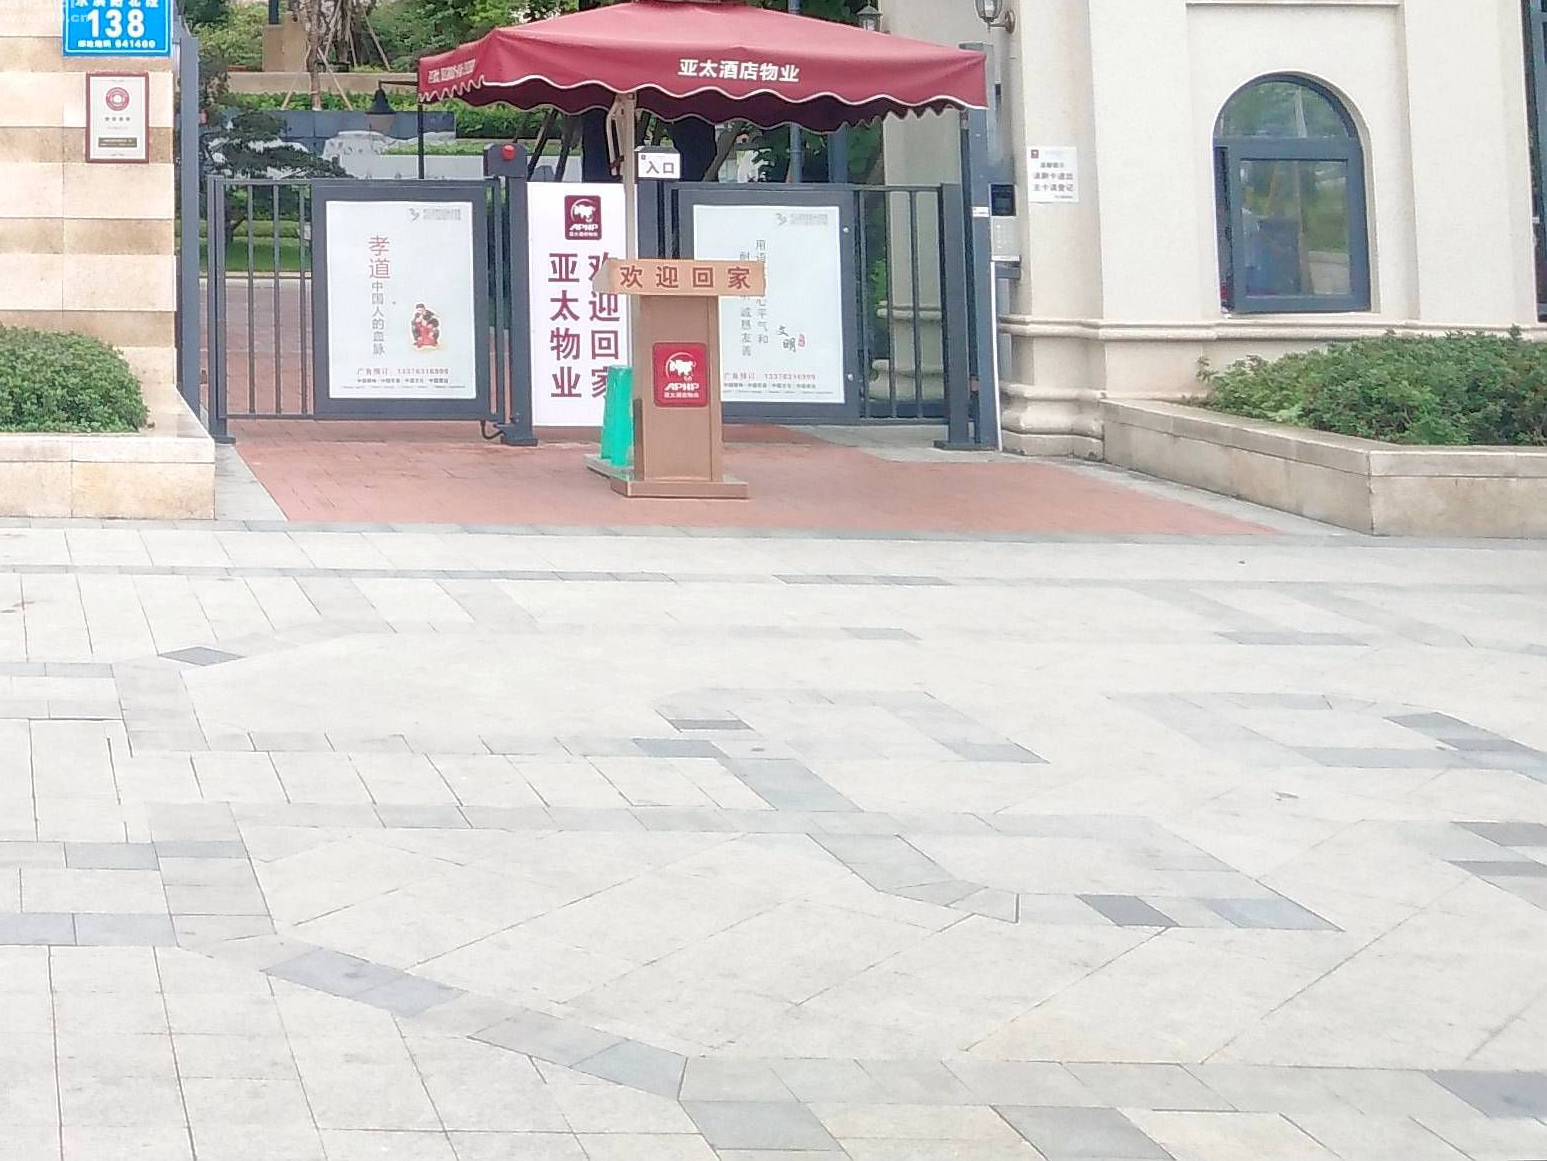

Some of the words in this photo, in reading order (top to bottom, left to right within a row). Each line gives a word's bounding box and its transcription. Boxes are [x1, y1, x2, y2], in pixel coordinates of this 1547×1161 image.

[87, 8, 145, 39] 138
[114, 40, 156, 48] 641400
[677, 58, 800, 82] 亚太酒店物业
[646, 160, 674, 174] 入口
[368, 235, 391, 280] 孝道
[620, 265, 751, 289] 欢迎回家
[548, 252, 582, 398] 亚太物业
